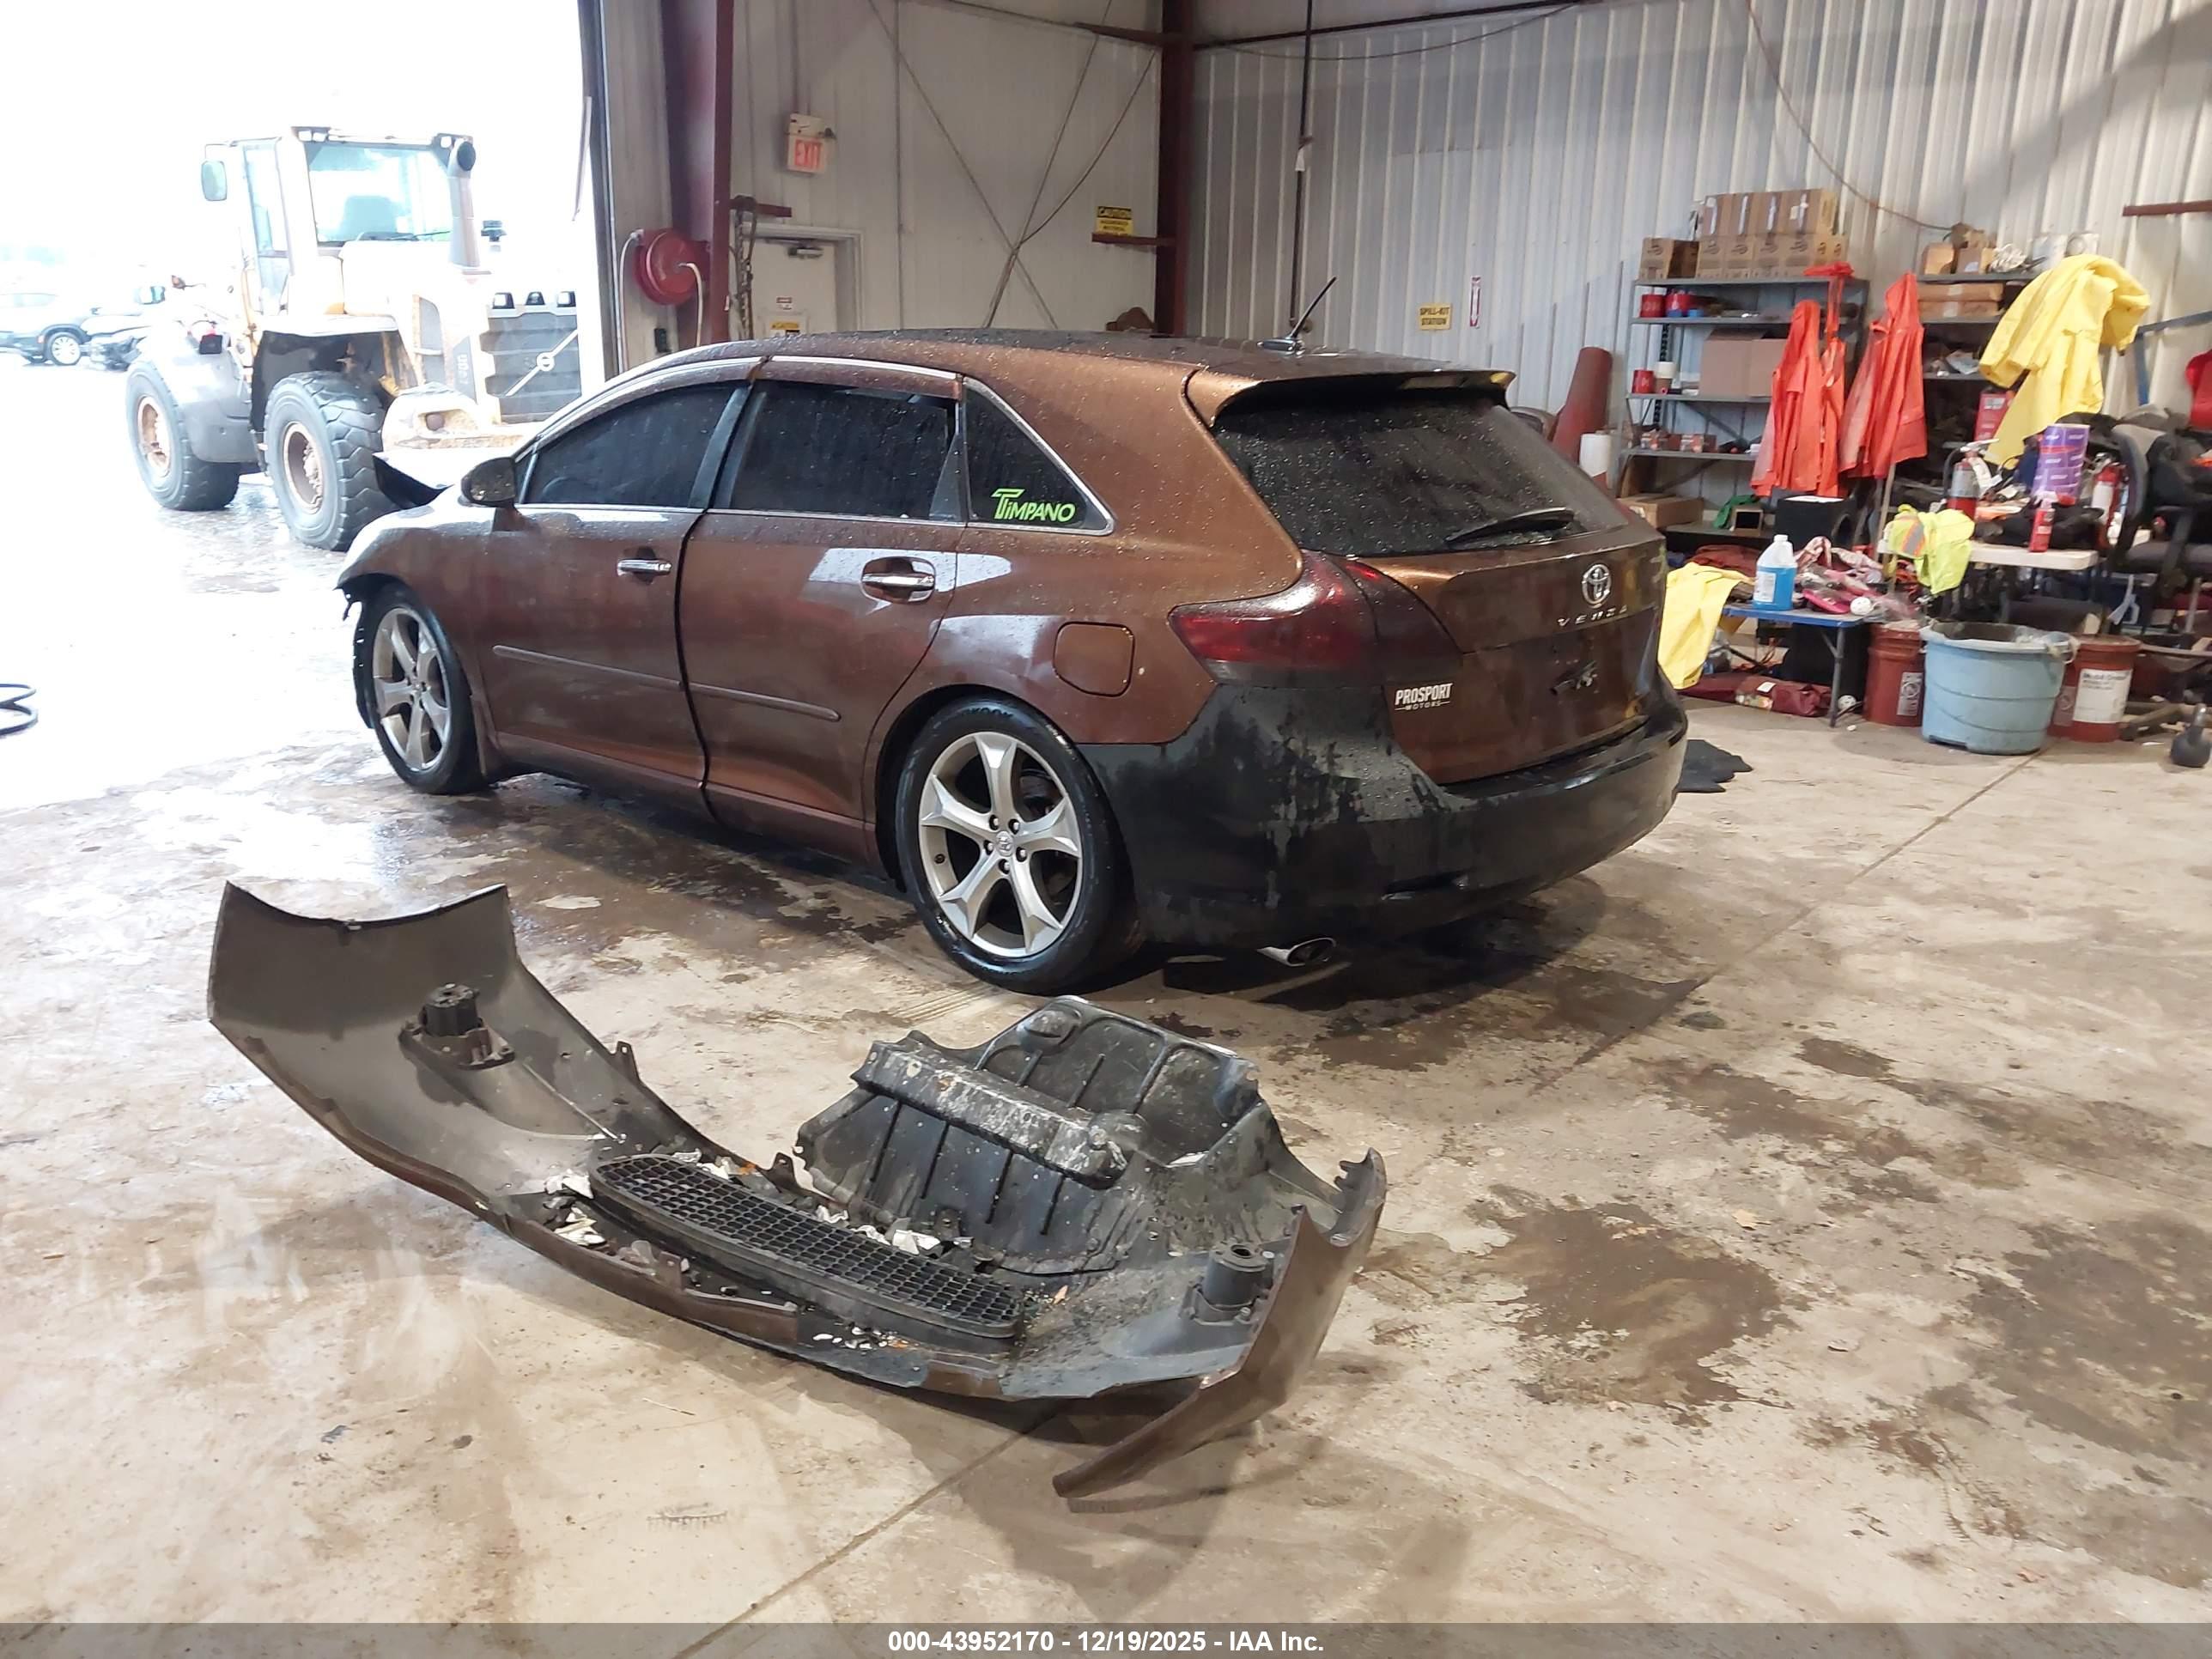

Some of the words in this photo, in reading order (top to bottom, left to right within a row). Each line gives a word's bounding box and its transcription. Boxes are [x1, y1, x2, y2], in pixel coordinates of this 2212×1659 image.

[795, 138, 823, 168] EXIT
[1557, 605, 1627, 627] VENZA
[1395, 683, 1453, 706] PROSPORT
[1405, 700, 1441, 711] MOTORS
